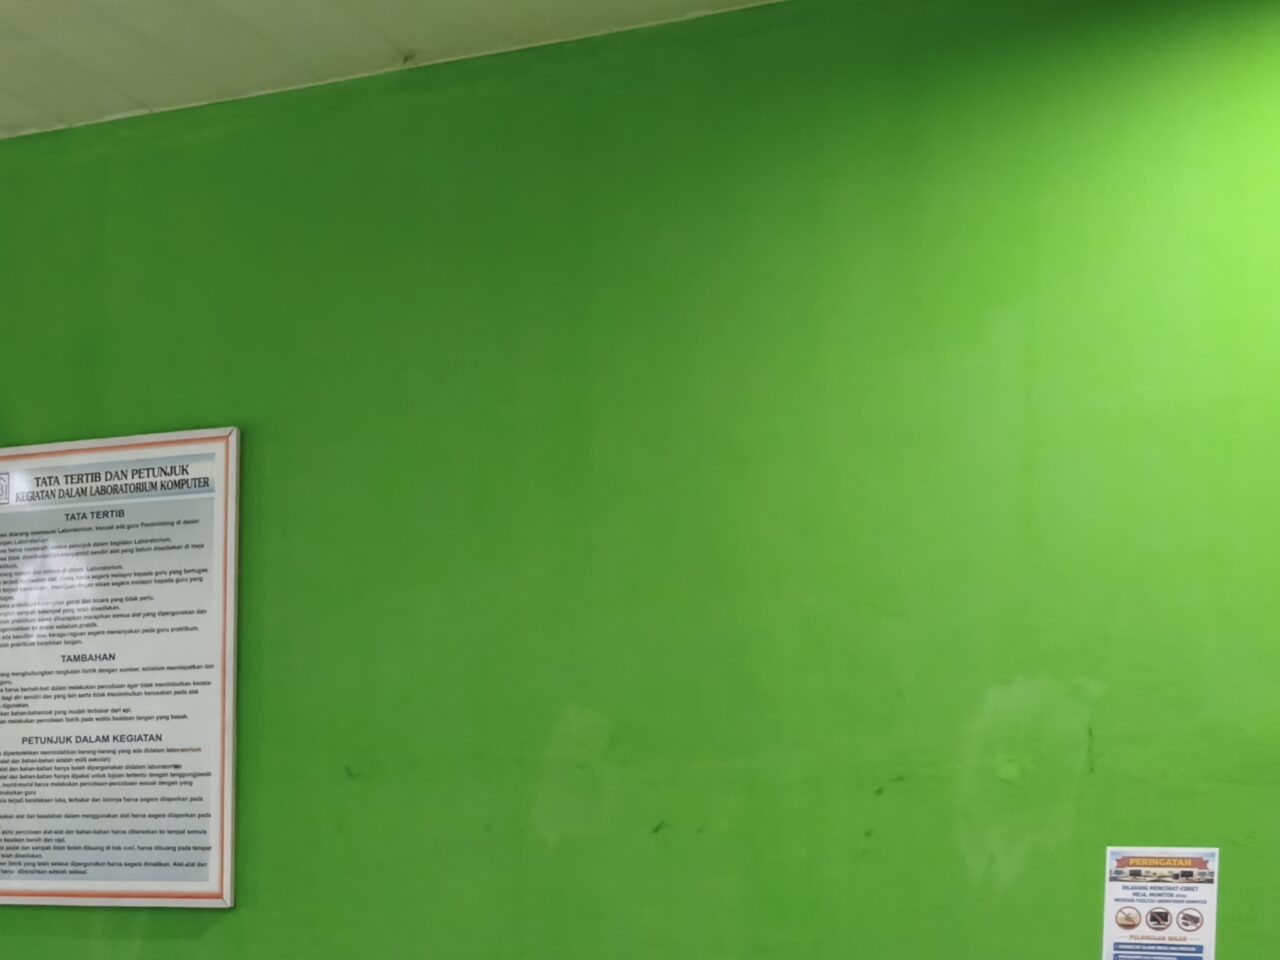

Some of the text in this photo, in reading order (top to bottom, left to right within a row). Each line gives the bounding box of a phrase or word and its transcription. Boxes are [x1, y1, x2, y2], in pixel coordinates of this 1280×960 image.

[34, 464, 189, 487] TATA TERTIB DAN PETUNJUK
[15, 477, 210, 503] KEGIATAN DALAM LABORATORIUM KOMPUTER
[64, 509, 125, 522] TATA TERTIB
[61, 653, 116, 663] TAMBAHAN
[22, 734, 162, 745] PETUNJUK DALAM KEGIATAN
[1129, 858, 1192, 867] PERINGATAN
